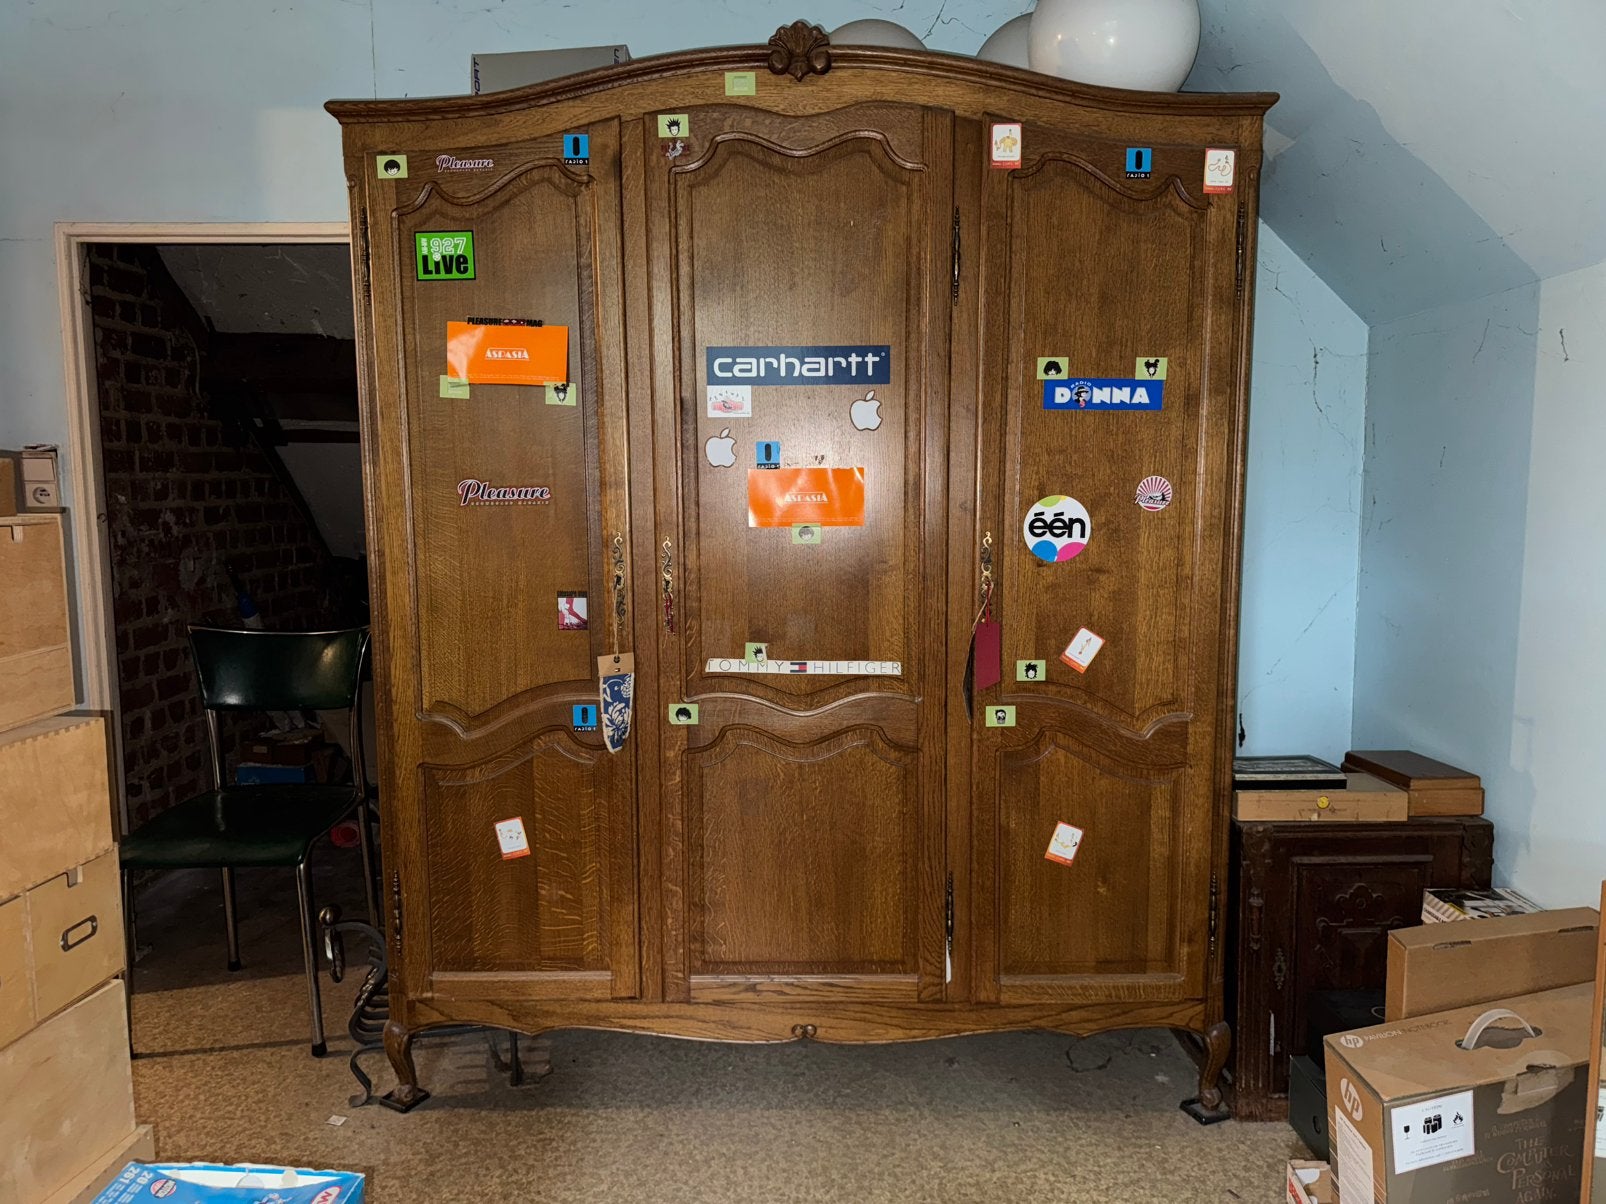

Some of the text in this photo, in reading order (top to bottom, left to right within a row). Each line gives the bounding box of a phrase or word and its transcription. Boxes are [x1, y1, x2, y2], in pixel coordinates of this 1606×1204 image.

[436, 154, 494, 172] Pleasure
[430, 237, 467, 254] 927
[467, 317, 543, 327] PLEASURE MAG
[485, 347, 529, 360] ASPASIA
[713, 352, 880, 378] carhartt
[1070, 380, 1092, 389] RADIO
[458, 479, 551, 506] Pleasure
[1028, 511, 1086, 538] één
[707, 658, 901, 675] TOMMY HILFIGER
[1514, 1136, 1545, 1150] THE
[1497, 1144, 1575, 1174] COMPUTER
[120, 1165, 141, 1184] 261
[136, 1170, 153, 1185] 20
[1511, 1164, 1577, 1190] PERSONAL
